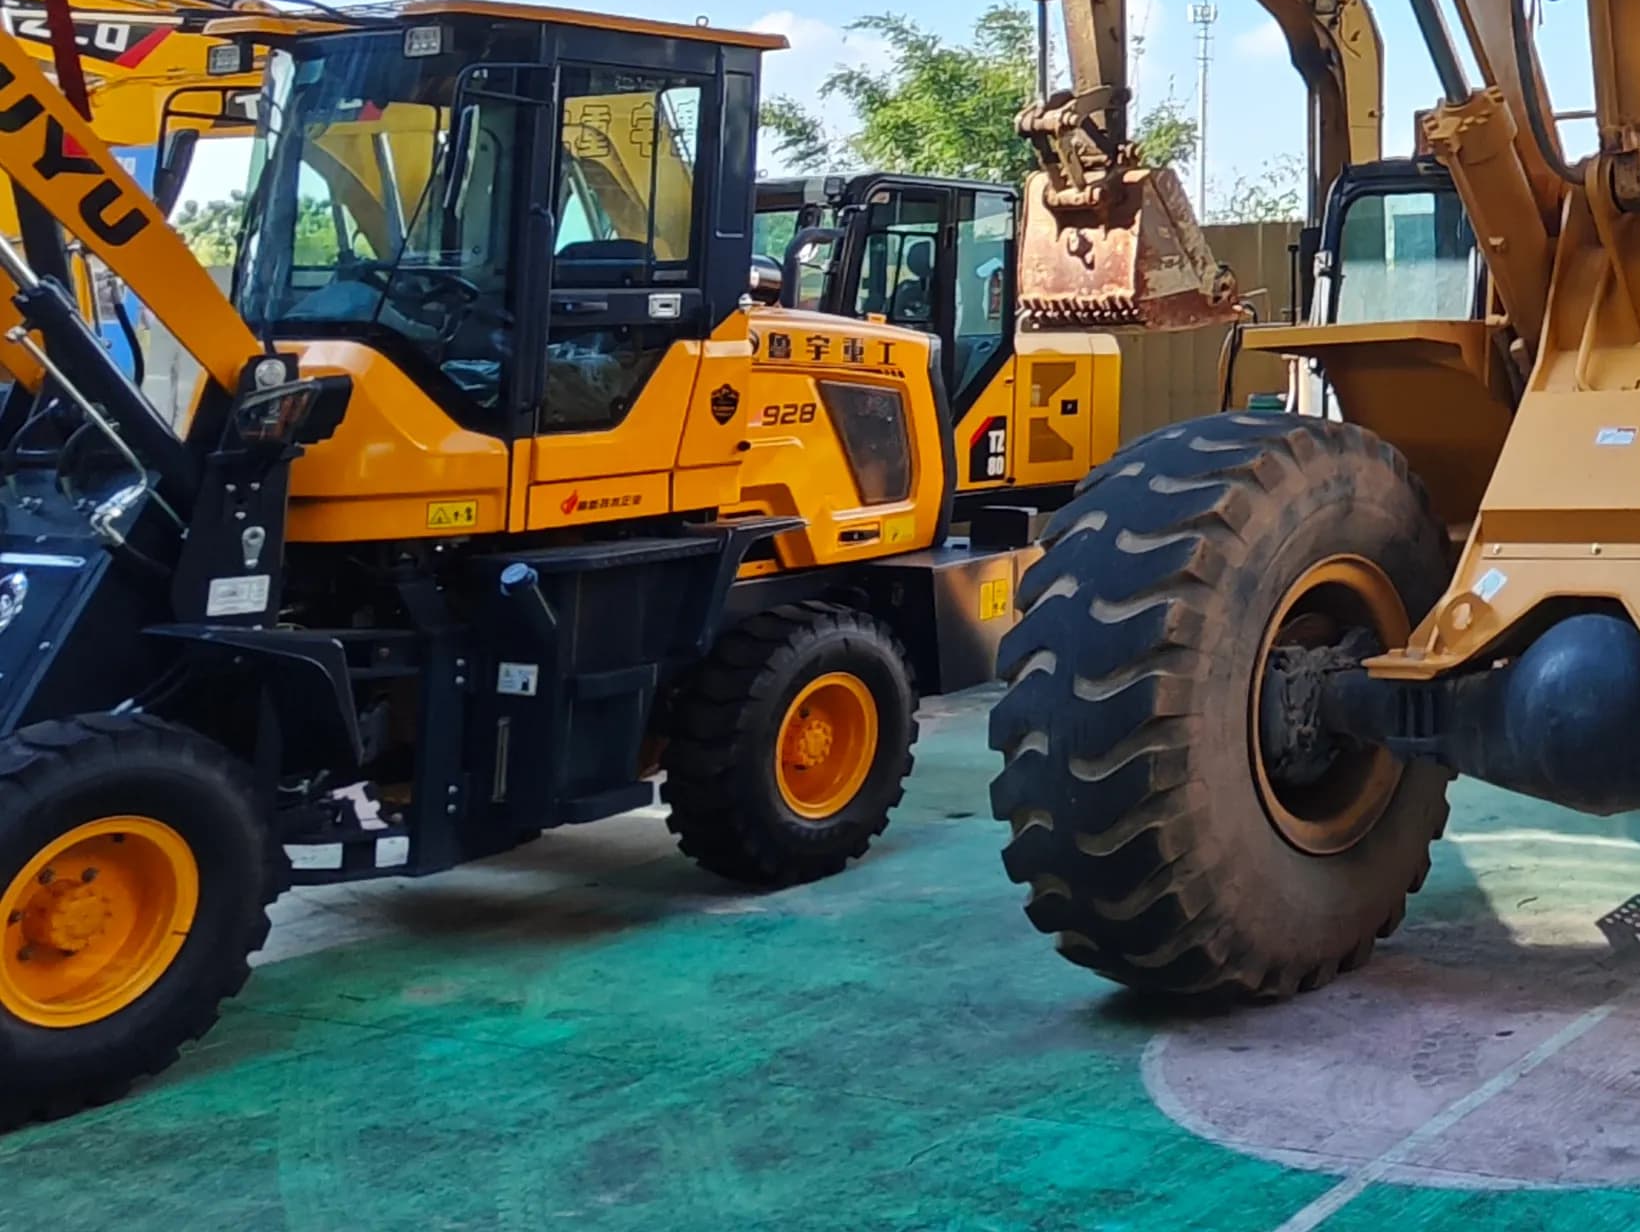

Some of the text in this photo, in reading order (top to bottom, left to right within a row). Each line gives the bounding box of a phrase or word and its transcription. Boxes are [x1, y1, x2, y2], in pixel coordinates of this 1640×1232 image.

[762, 402, 817, 426] 928
[988, 429, 1005, 453] TZ
[986, 454, 1005, 476] 80
